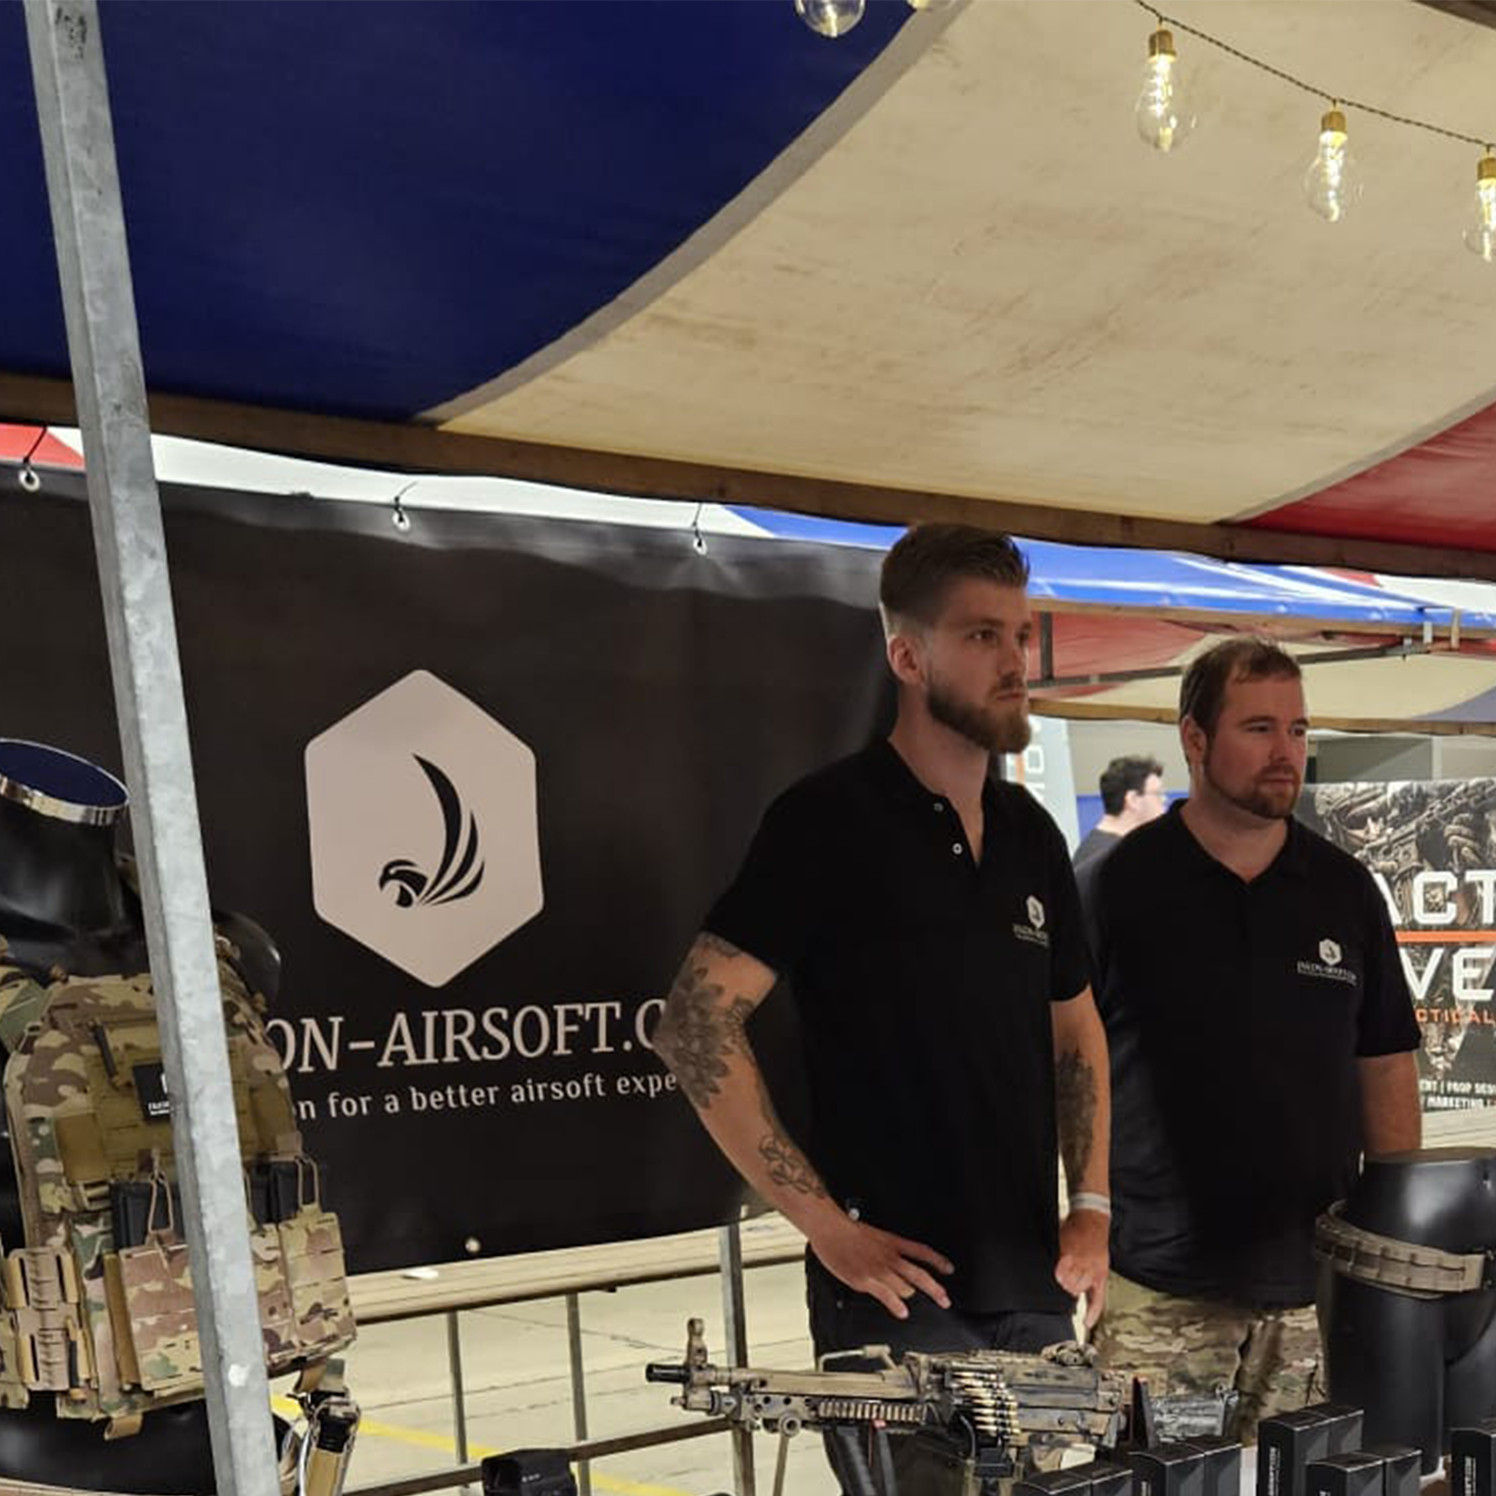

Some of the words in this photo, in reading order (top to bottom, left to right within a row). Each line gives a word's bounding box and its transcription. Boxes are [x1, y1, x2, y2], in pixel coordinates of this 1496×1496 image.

[328, 1091, 374, 1118] for
[384, 1097, 401, 1115] a
[409, 1083, 500, 1112] better
[510, 1072, 606, 1103] airsoft
